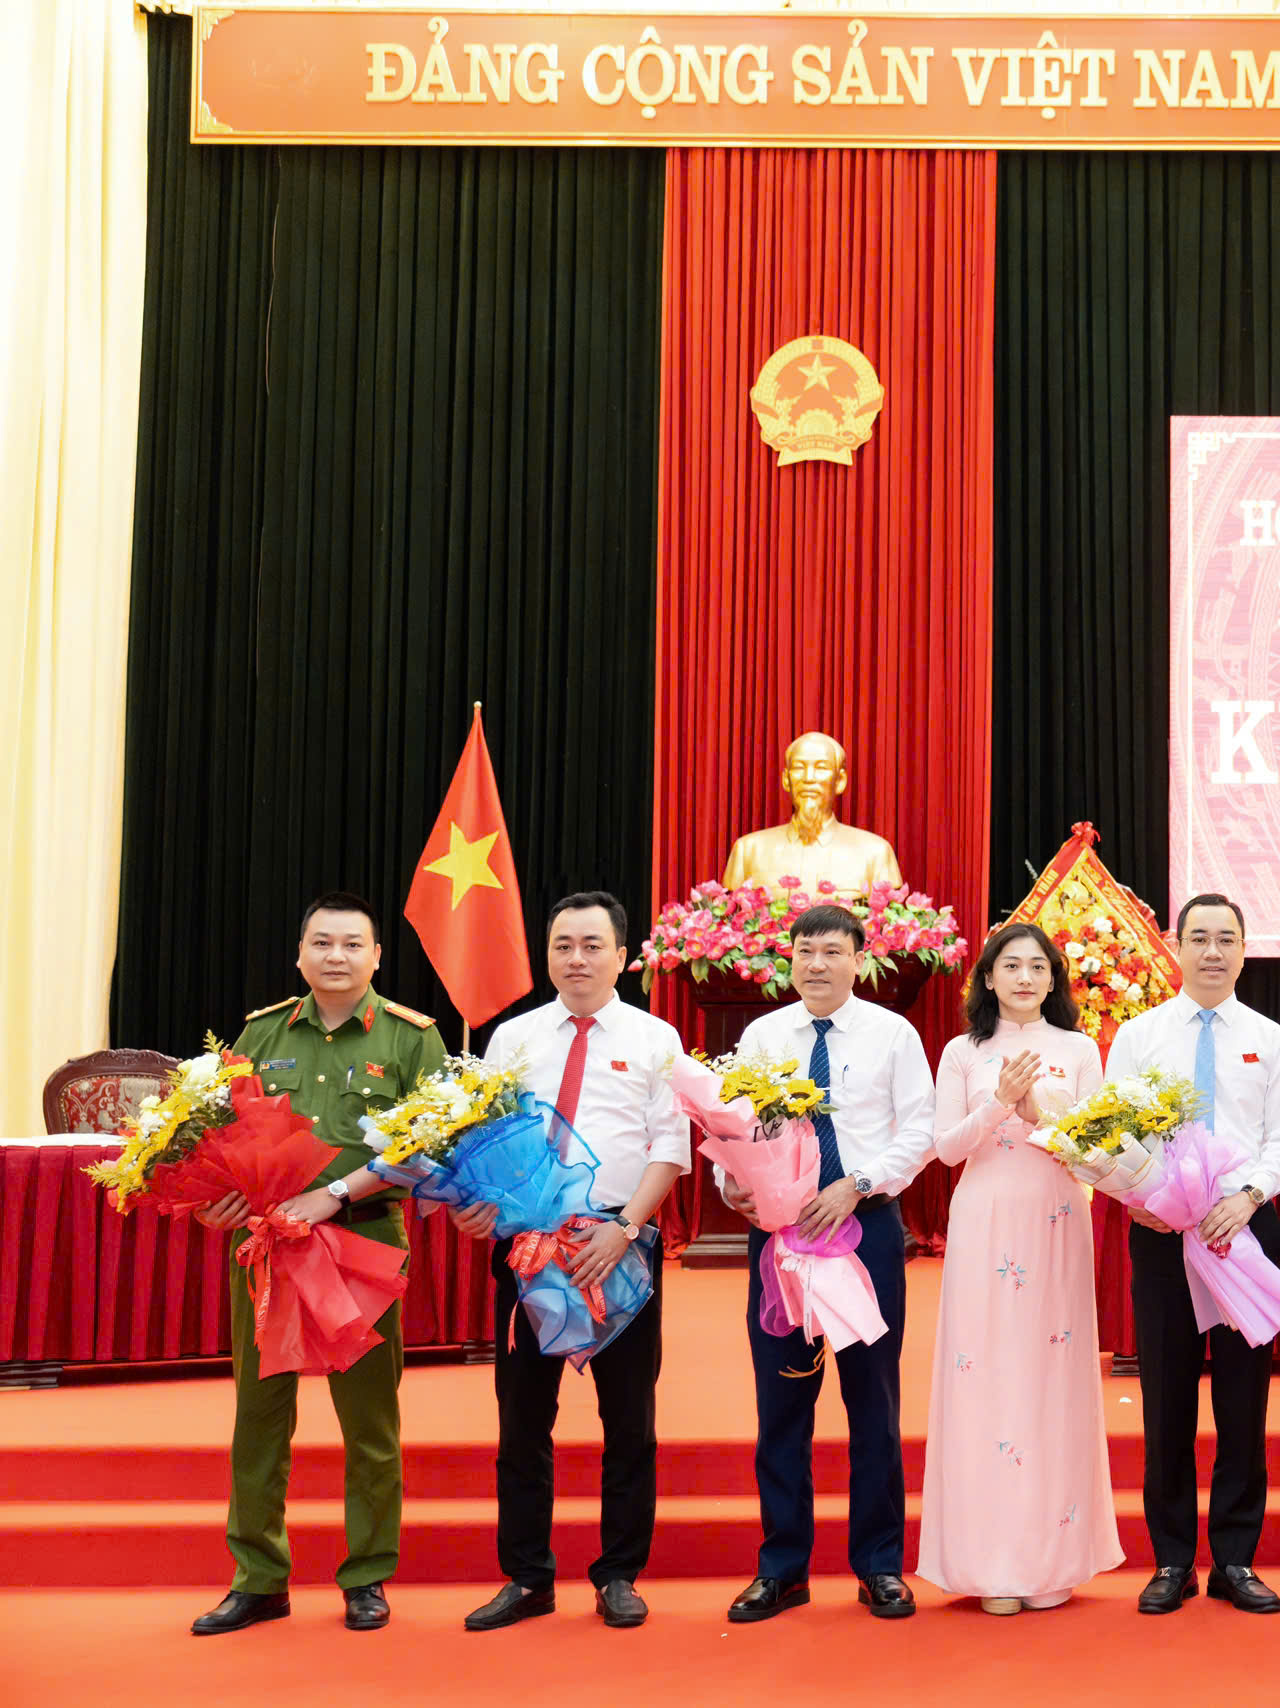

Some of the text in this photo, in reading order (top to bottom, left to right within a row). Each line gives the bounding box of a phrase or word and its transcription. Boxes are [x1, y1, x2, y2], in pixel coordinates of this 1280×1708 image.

[365, 16, 565, 105] ĐẢNG
[582, 25, 775, 119] CỘNG
[791, 20, 934, 105] SẢN
[951, 29, 1116, 120] VIỆT
